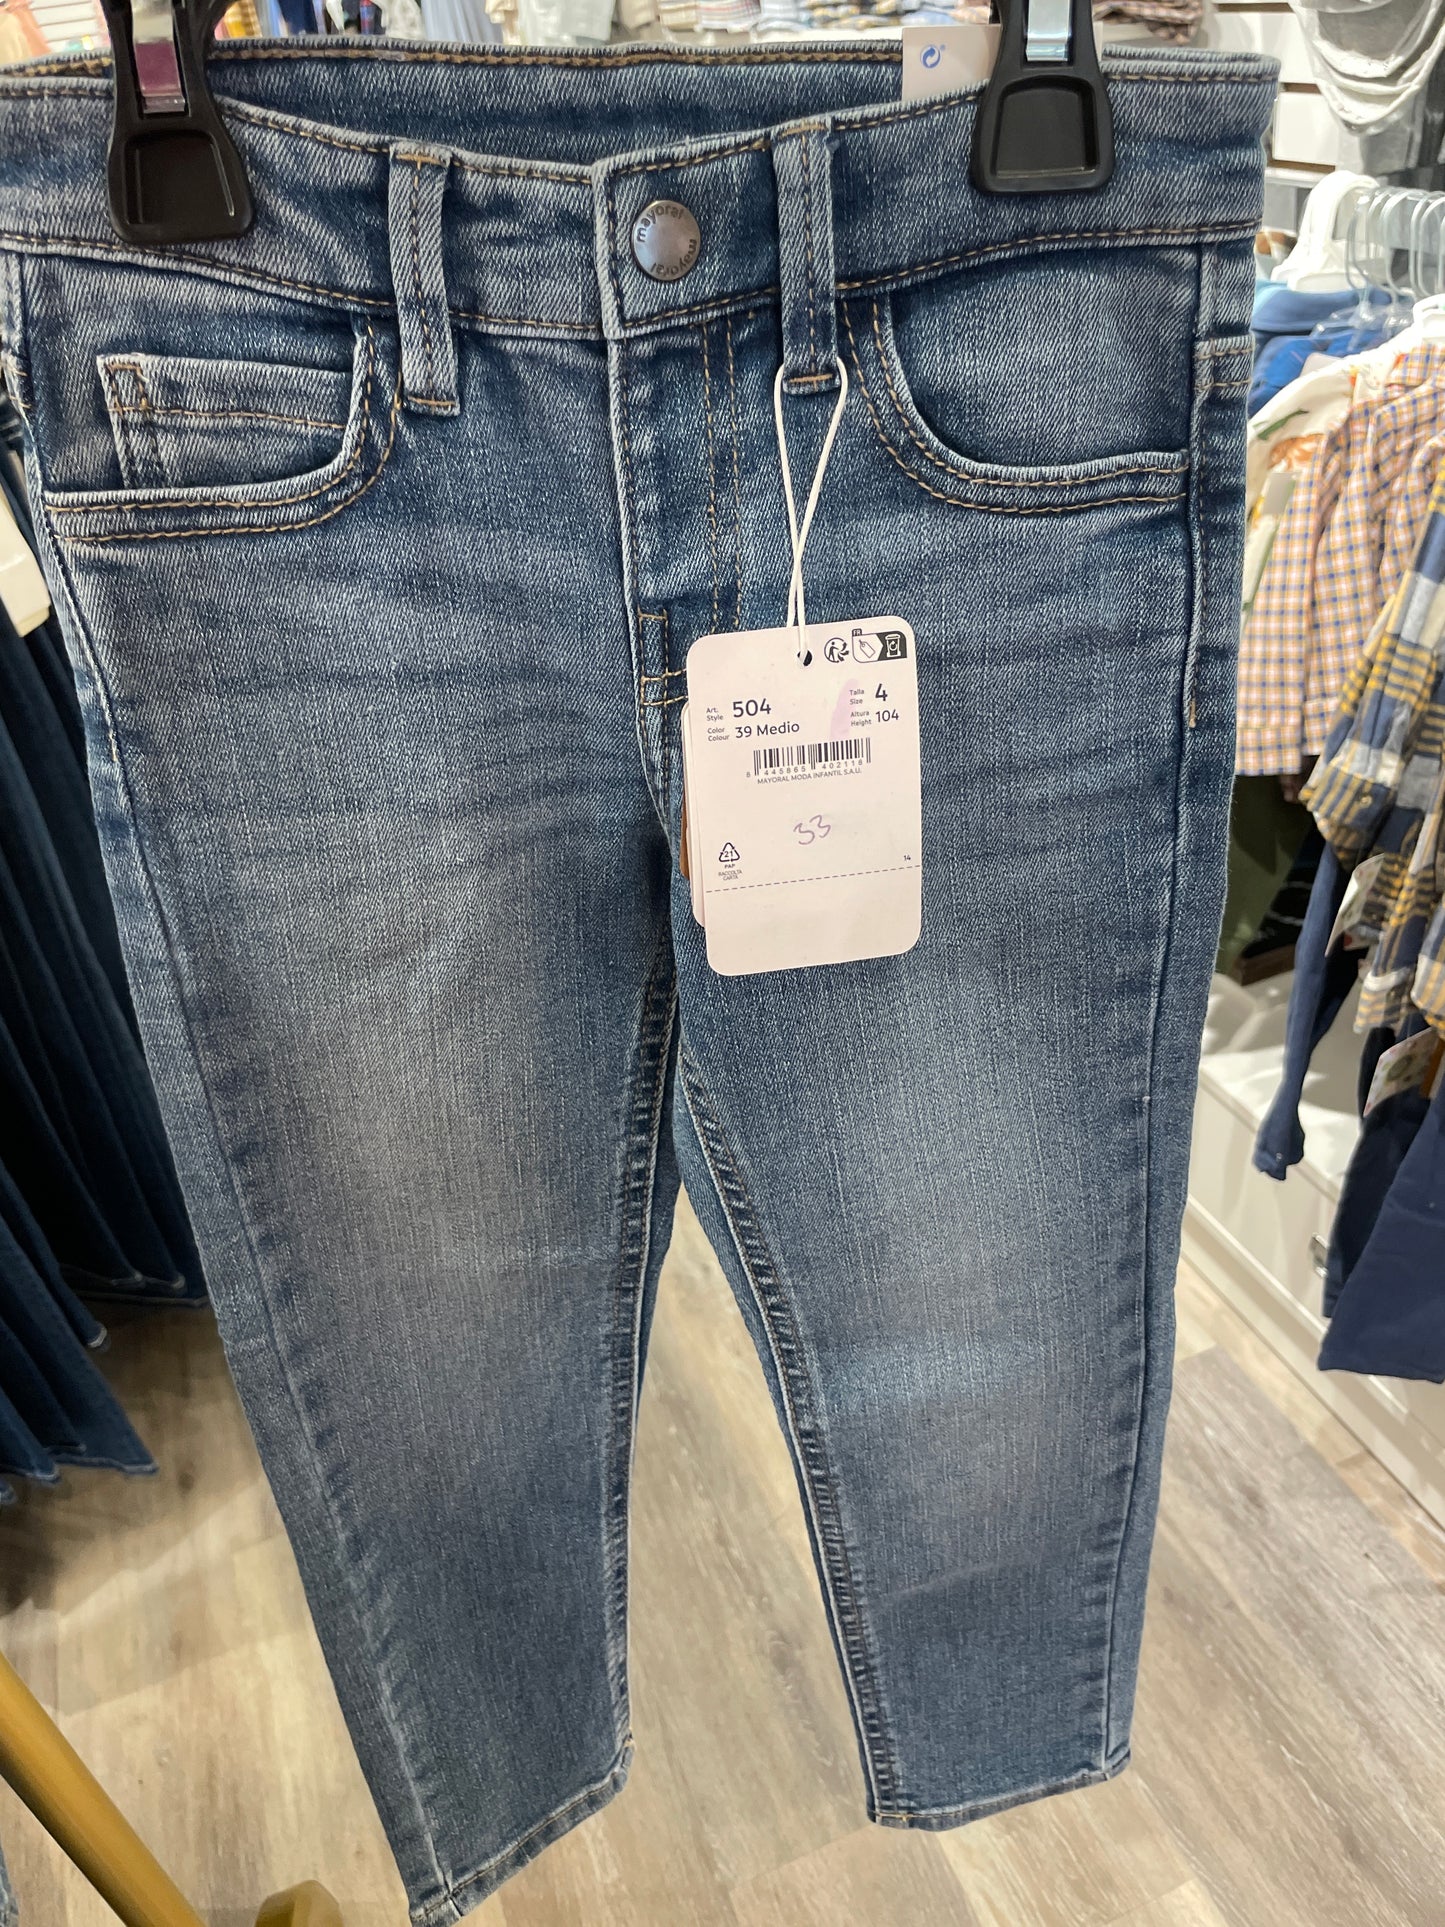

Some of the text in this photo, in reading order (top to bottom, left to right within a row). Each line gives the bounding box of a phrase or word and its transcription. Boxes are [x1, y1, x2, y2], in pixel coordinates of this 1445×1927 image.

[636, 204, 685, 243] mayoral
[650, 238, 697, 277] mayoral
[875, 683, 888, 702] 4
[732, 698, 772, 718] 504
[875, 709, 899, 723] 104
[735, 721, 800, 739] 39 Medio
[850, 719, 872, 727] Height
[708, 734, 730, 742] Colour
[757, 776, 790, 785] MAYORAL
[791, 773, 812, 782] MODA
[813, 770, 841, 779] INFANTIL
[724, 850, 734, 858] 21
